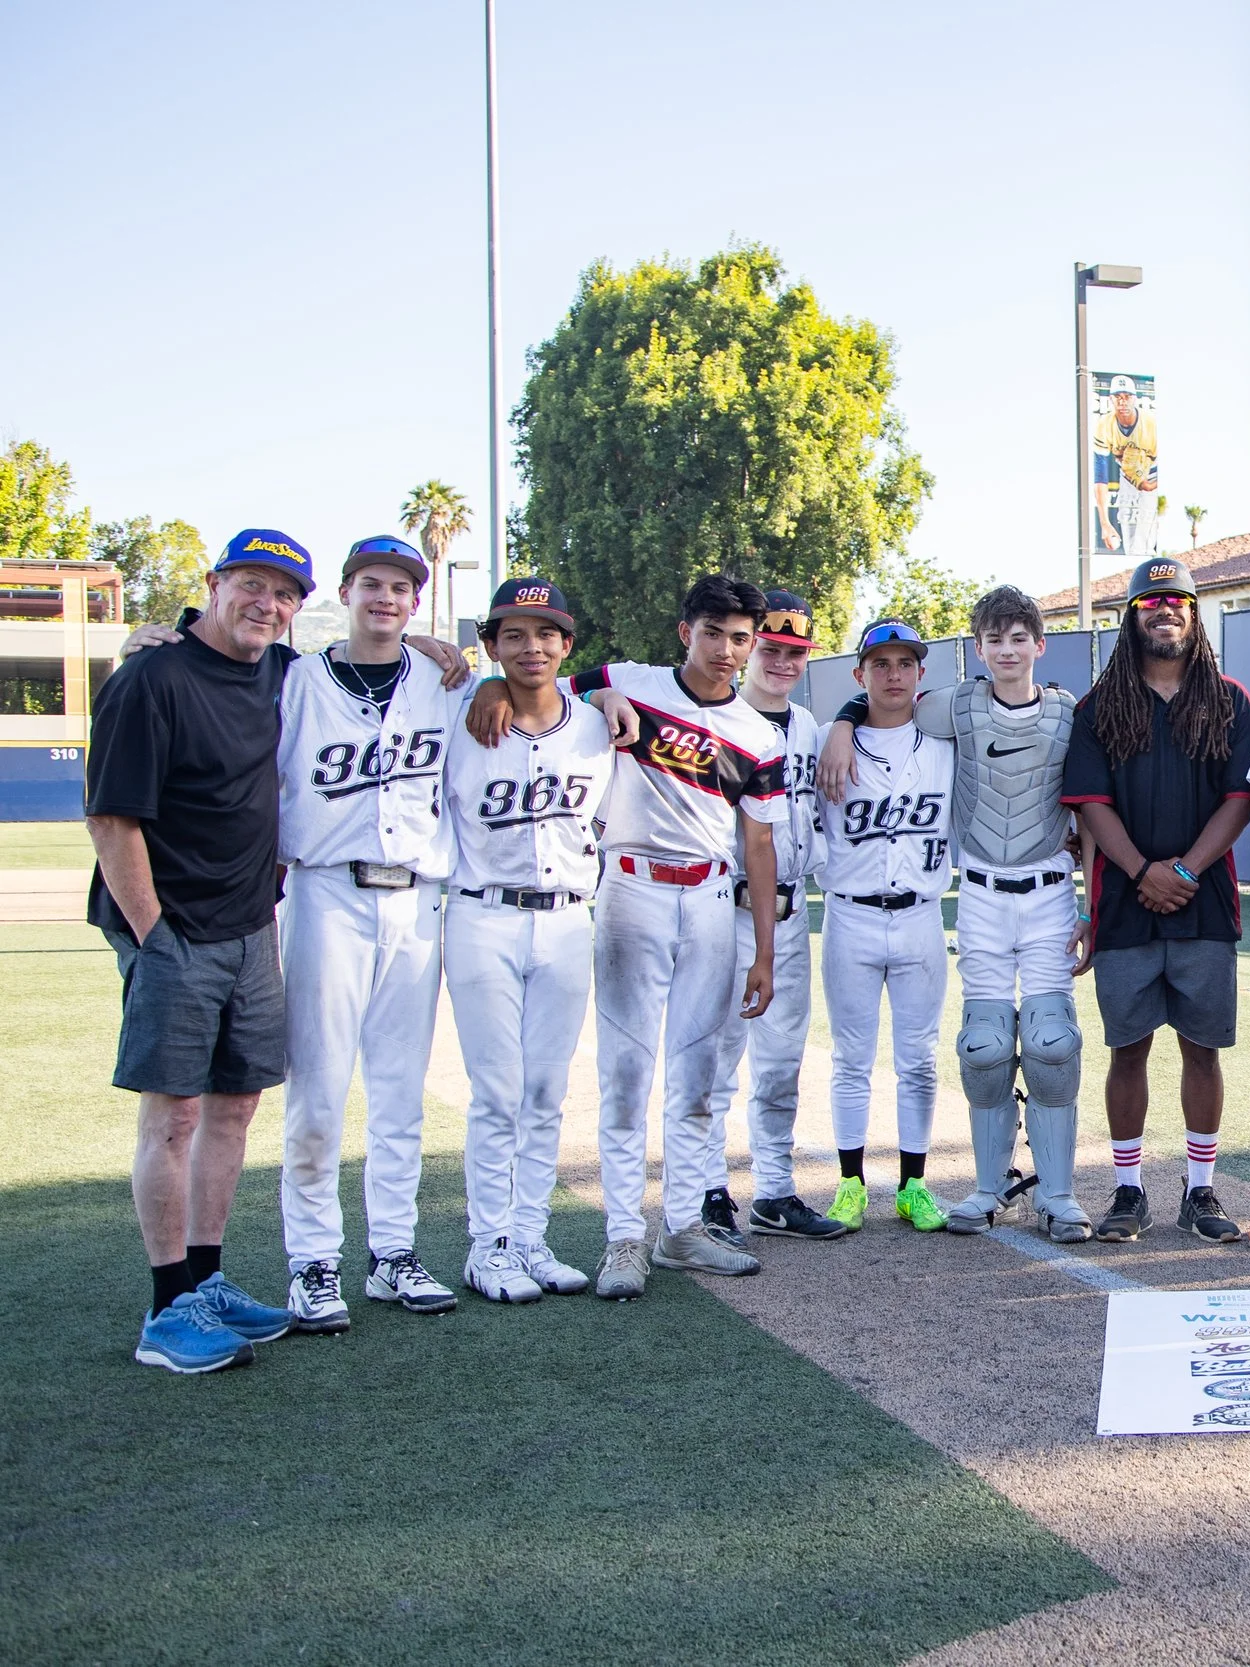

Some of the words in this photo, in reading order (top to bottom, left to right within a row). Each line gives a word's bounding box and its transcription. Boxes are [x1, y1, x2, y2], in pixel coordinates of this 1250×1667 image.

[1149, 564, 1177, 578] 365
[515, 587, 550, 603] 365
[50, 748, 78, 760] 310
[310, 727, 445, 788] 365
[648, 724, 721, 767] 365
[782, 752, 818, 789] 65
[478, 773, 596, 819] 365
[843, 792, 946, 837] 365
[921, 838, 949, 873] 15
